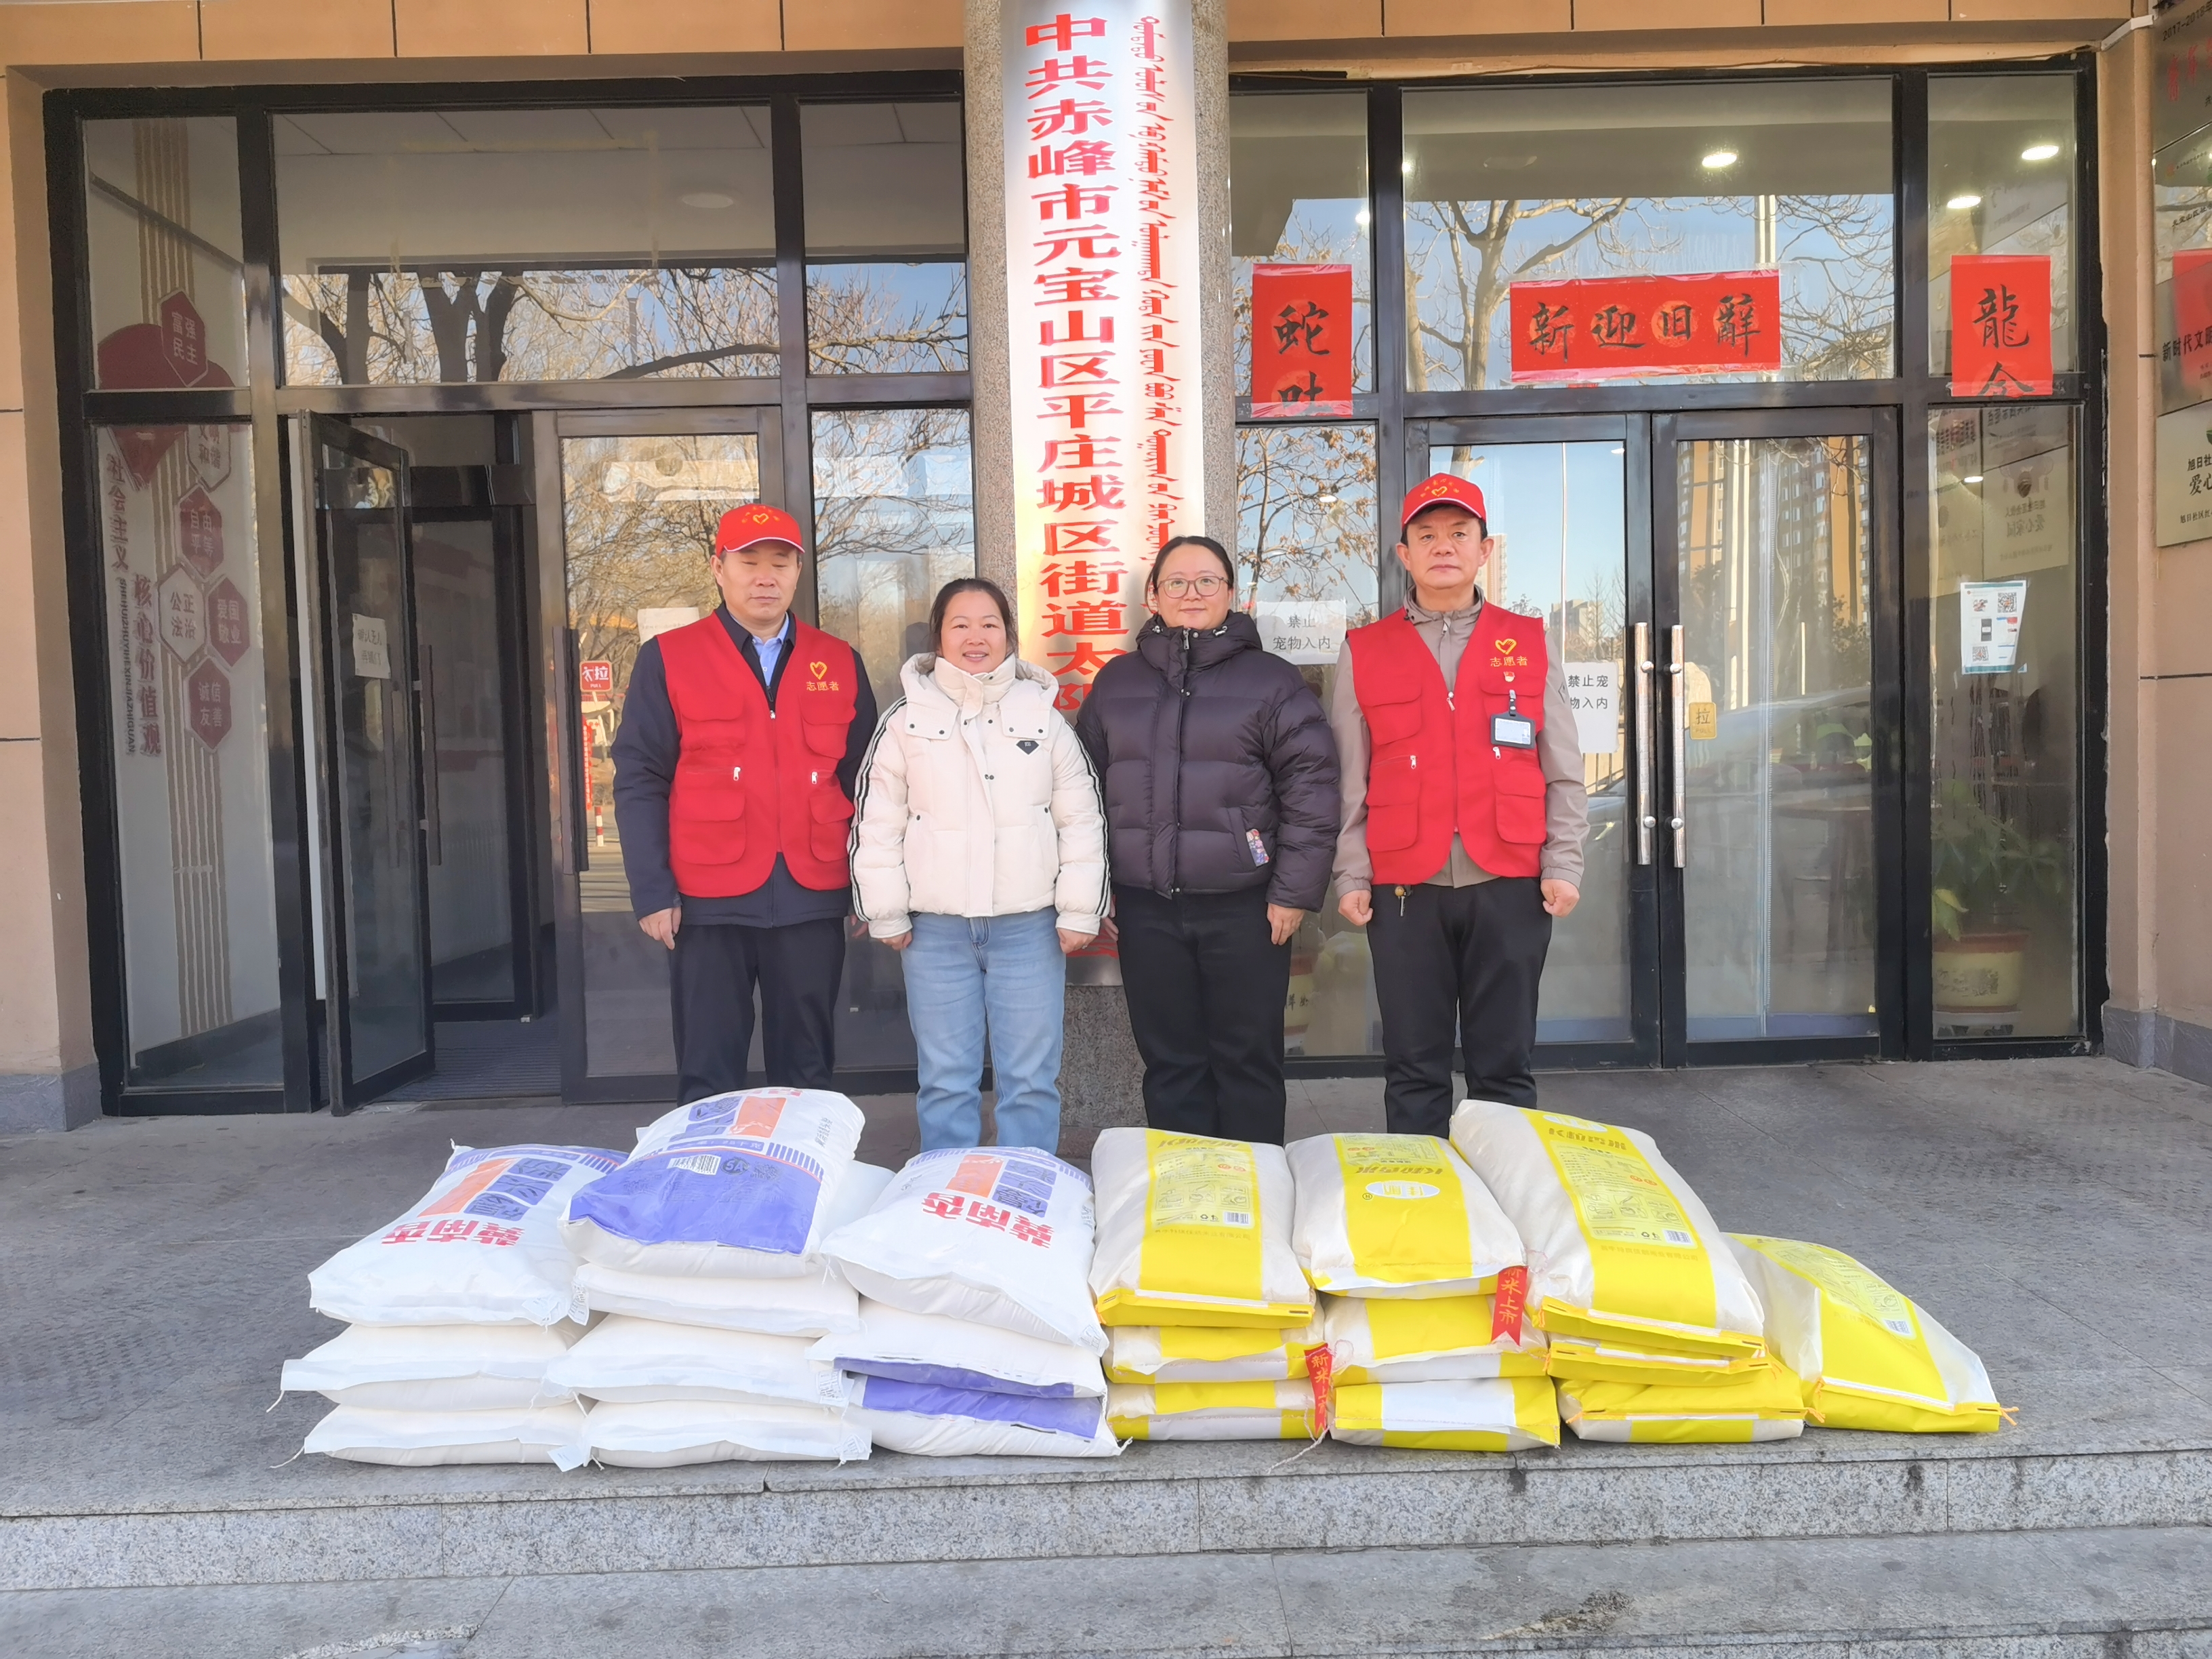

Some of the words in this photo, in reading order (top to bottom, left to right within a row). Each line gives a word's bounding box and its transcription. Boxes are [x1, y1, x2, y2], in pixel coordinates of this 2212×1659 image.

[169, 590, 195, 615] 公正
[217, 598, 241, 621] 爱国
[171, 615, 197, 640] 法治
[1287, 615, 1317, 628] 禁止
[1273, 636, 1331, 651] 宠物入内
[1490, 655, 1528, 667] 志愿者
[594, 665, 609, 680] 拉
[806, 680, 840, 691] 志愿者
[1568, 674, 1610, 689] 禁止宠
[198, 680, 222, 703] 诚信
[199, 706, 224, 729] 友善
[1696, 708, 1711, 724] 拉
[725, 1159, 744, 1172] 5A
